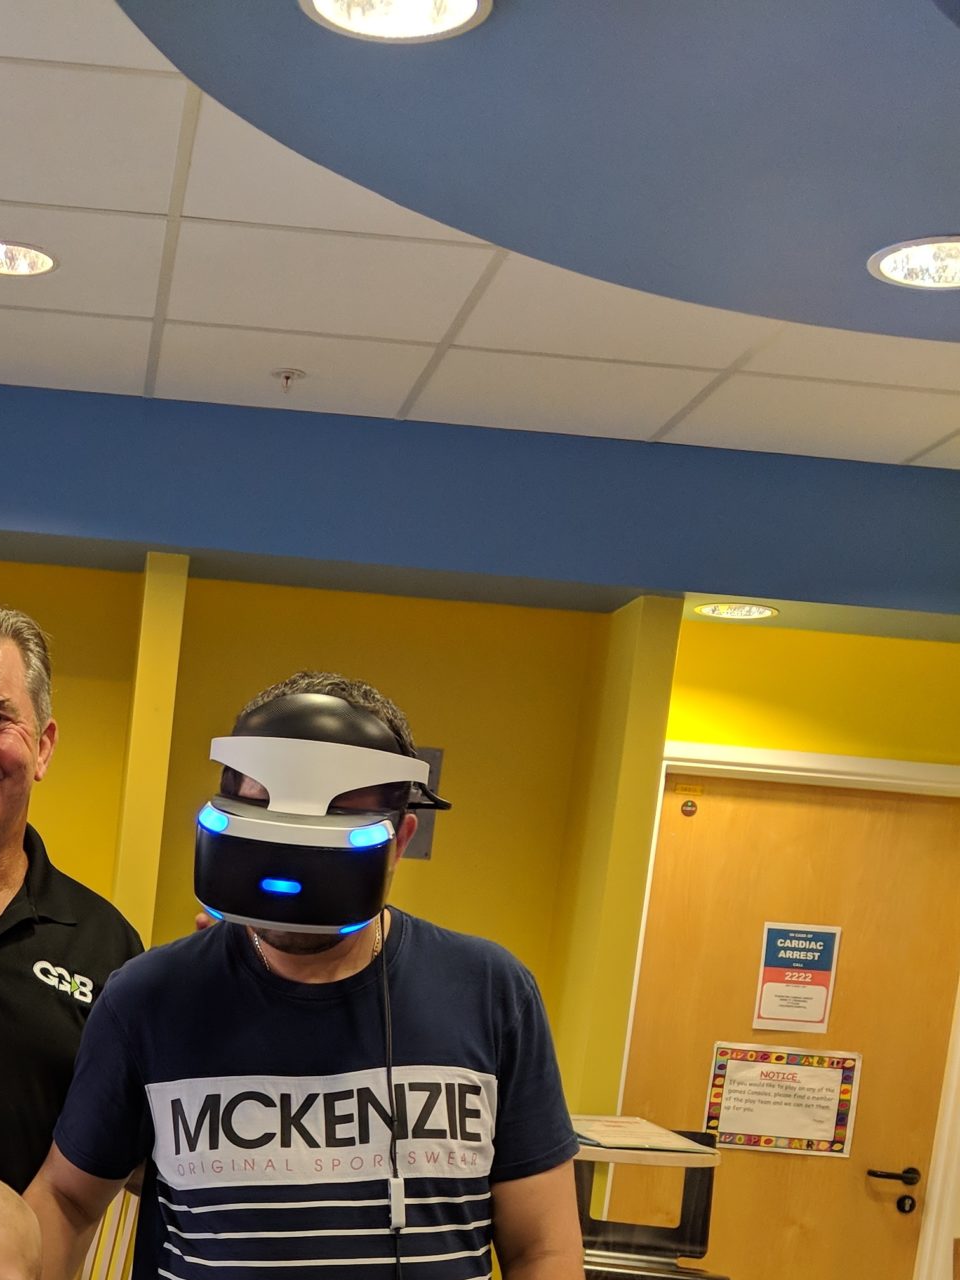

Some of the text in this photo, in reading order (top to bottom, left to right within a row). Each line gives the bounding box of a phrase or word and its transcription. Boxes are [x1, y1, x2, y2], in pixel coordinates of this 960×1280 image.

[777, 938, 824, 950] CARDIAC
[778, 950, 820, 961] ARREST
[784, 971, 813, 982] 2222
[171, 1082, 482, 1155] MCKENZIE
[176, 1158, 293, 1177] ORIGINAL
